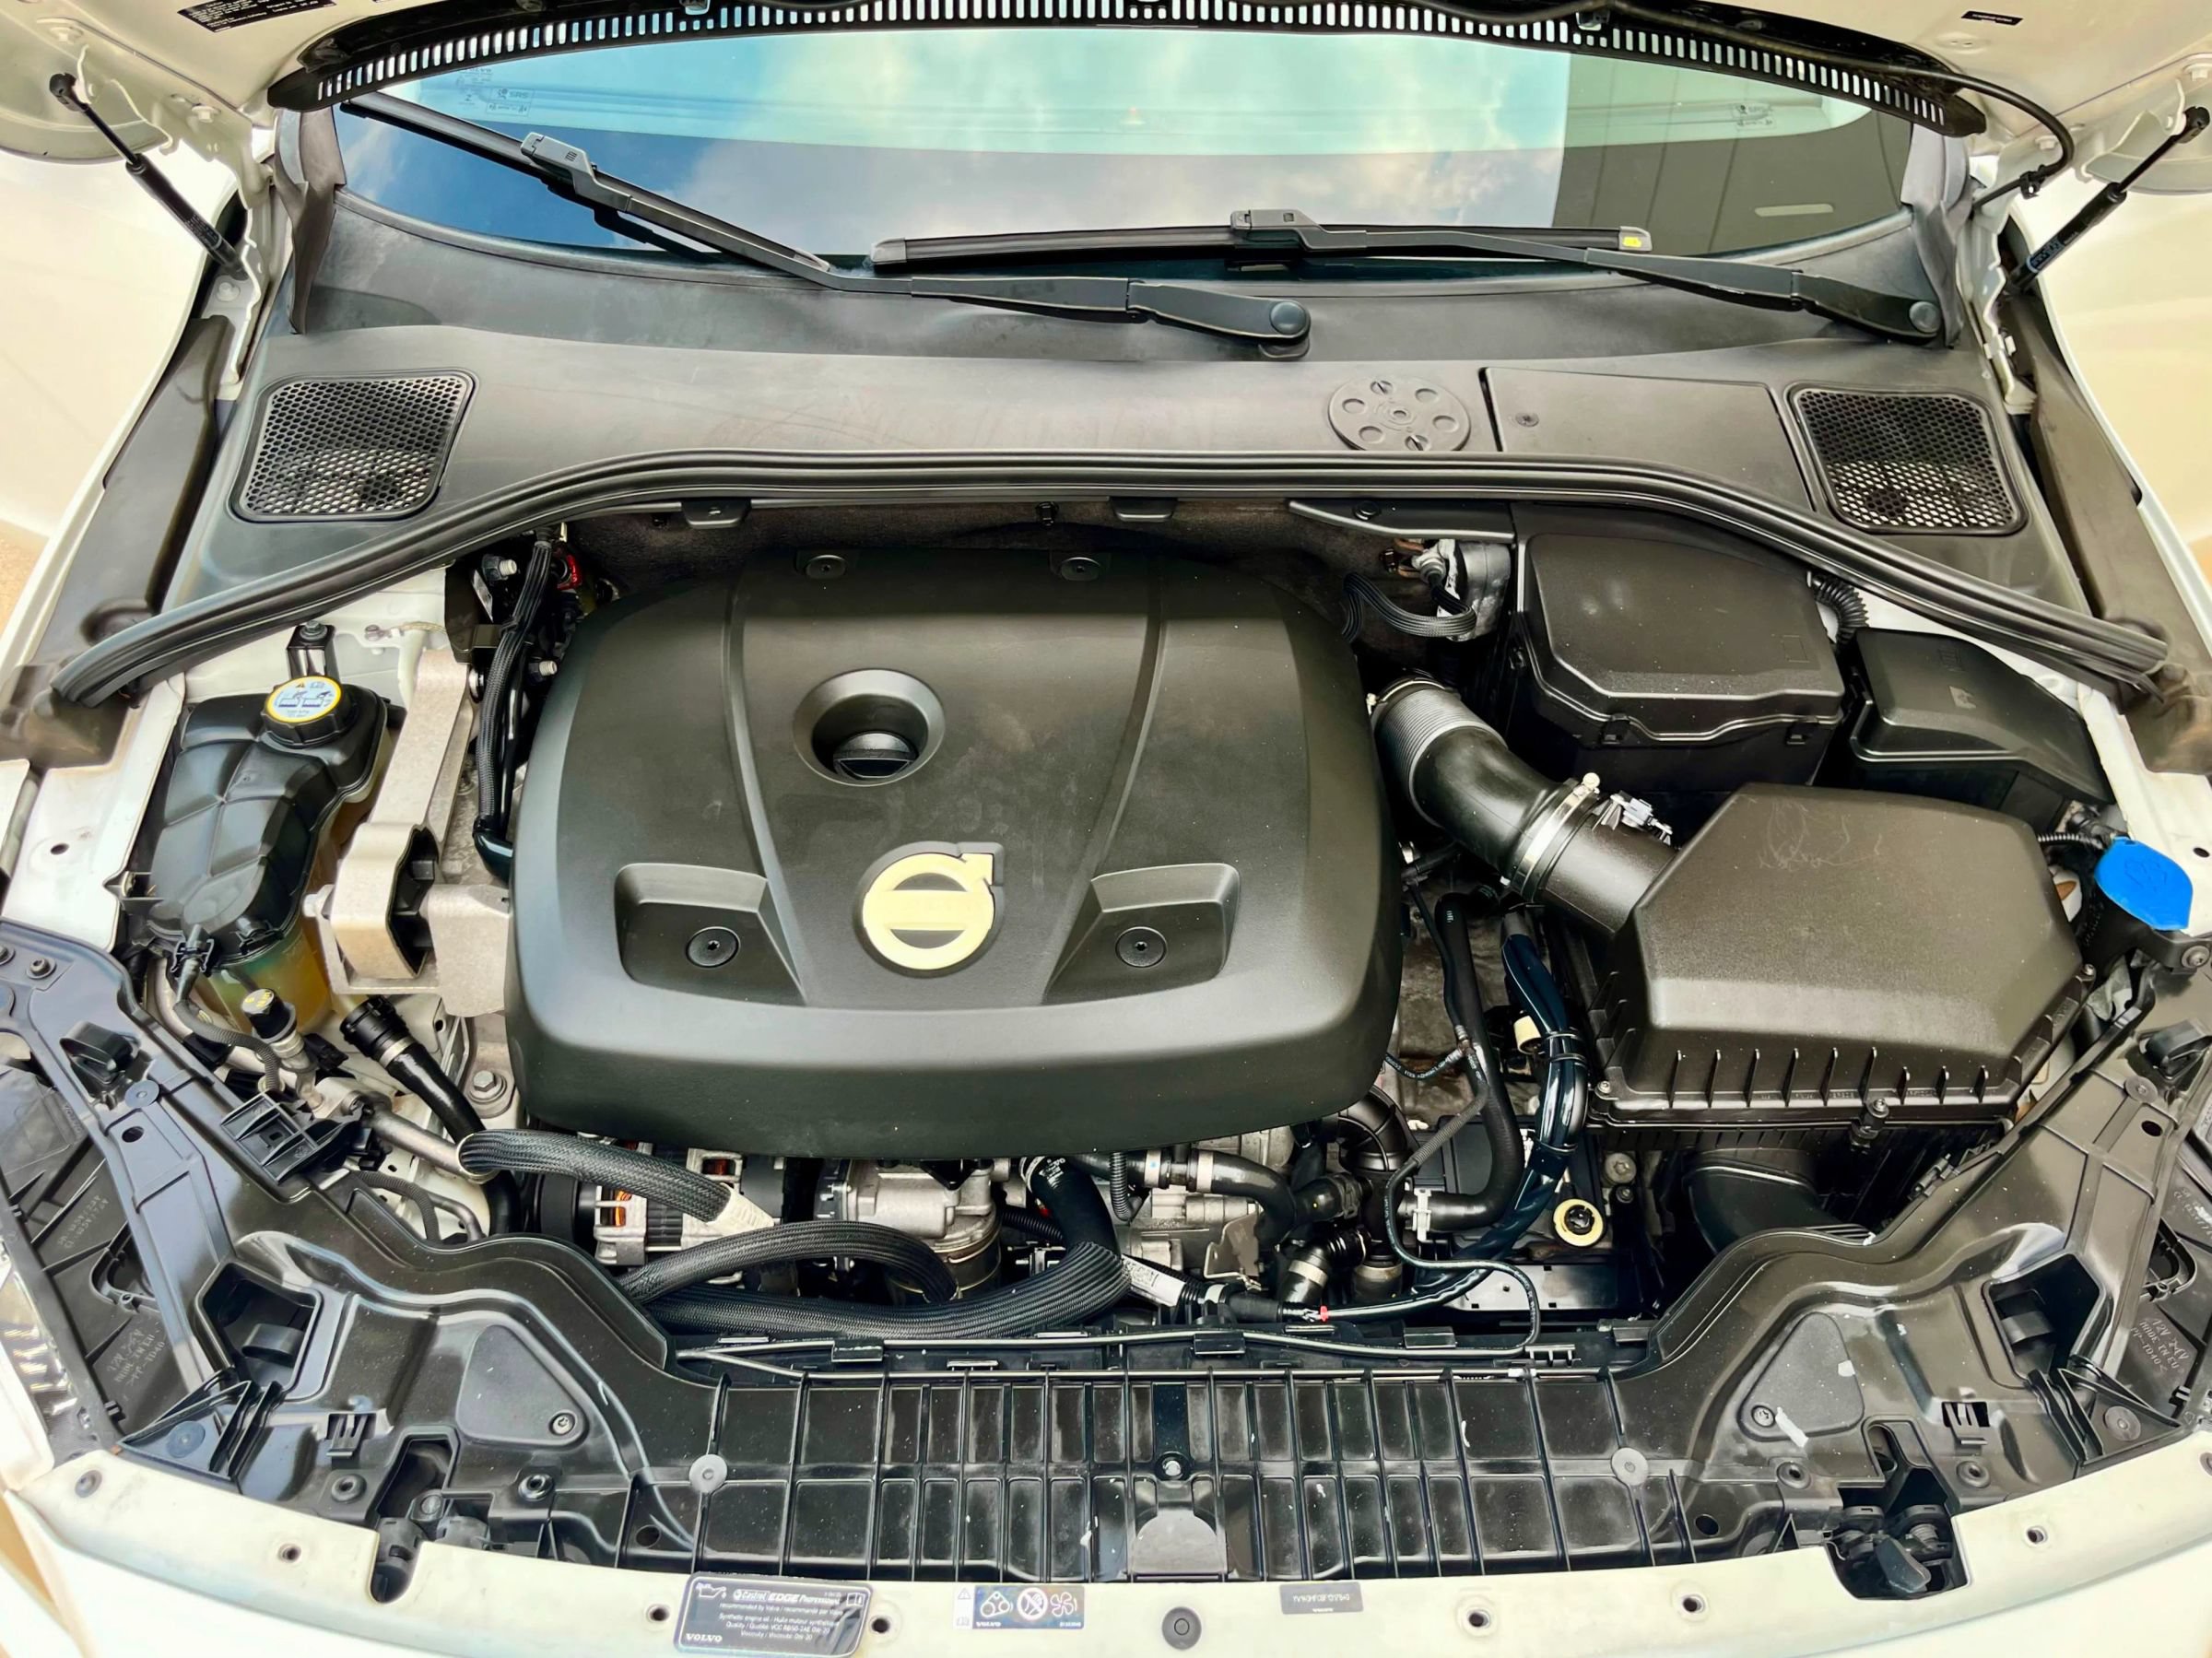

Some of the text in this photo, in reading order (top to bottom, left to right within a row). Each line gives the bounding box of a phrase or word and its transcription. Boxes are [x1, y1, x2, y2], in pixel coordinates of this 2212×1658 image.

[2152, 1320, 2171, 1336] 12V
[2167, 1356, 2181, 1370] EU
[742, 1591, 768, 1601] Castrol
[768, 1592, 800, 1602] EDGE
[719, 1612, 743, 1621] Synthetic
[725, 1621, 746, 1629] Quality
[686, 1633, 724, 1643] VOLVO
